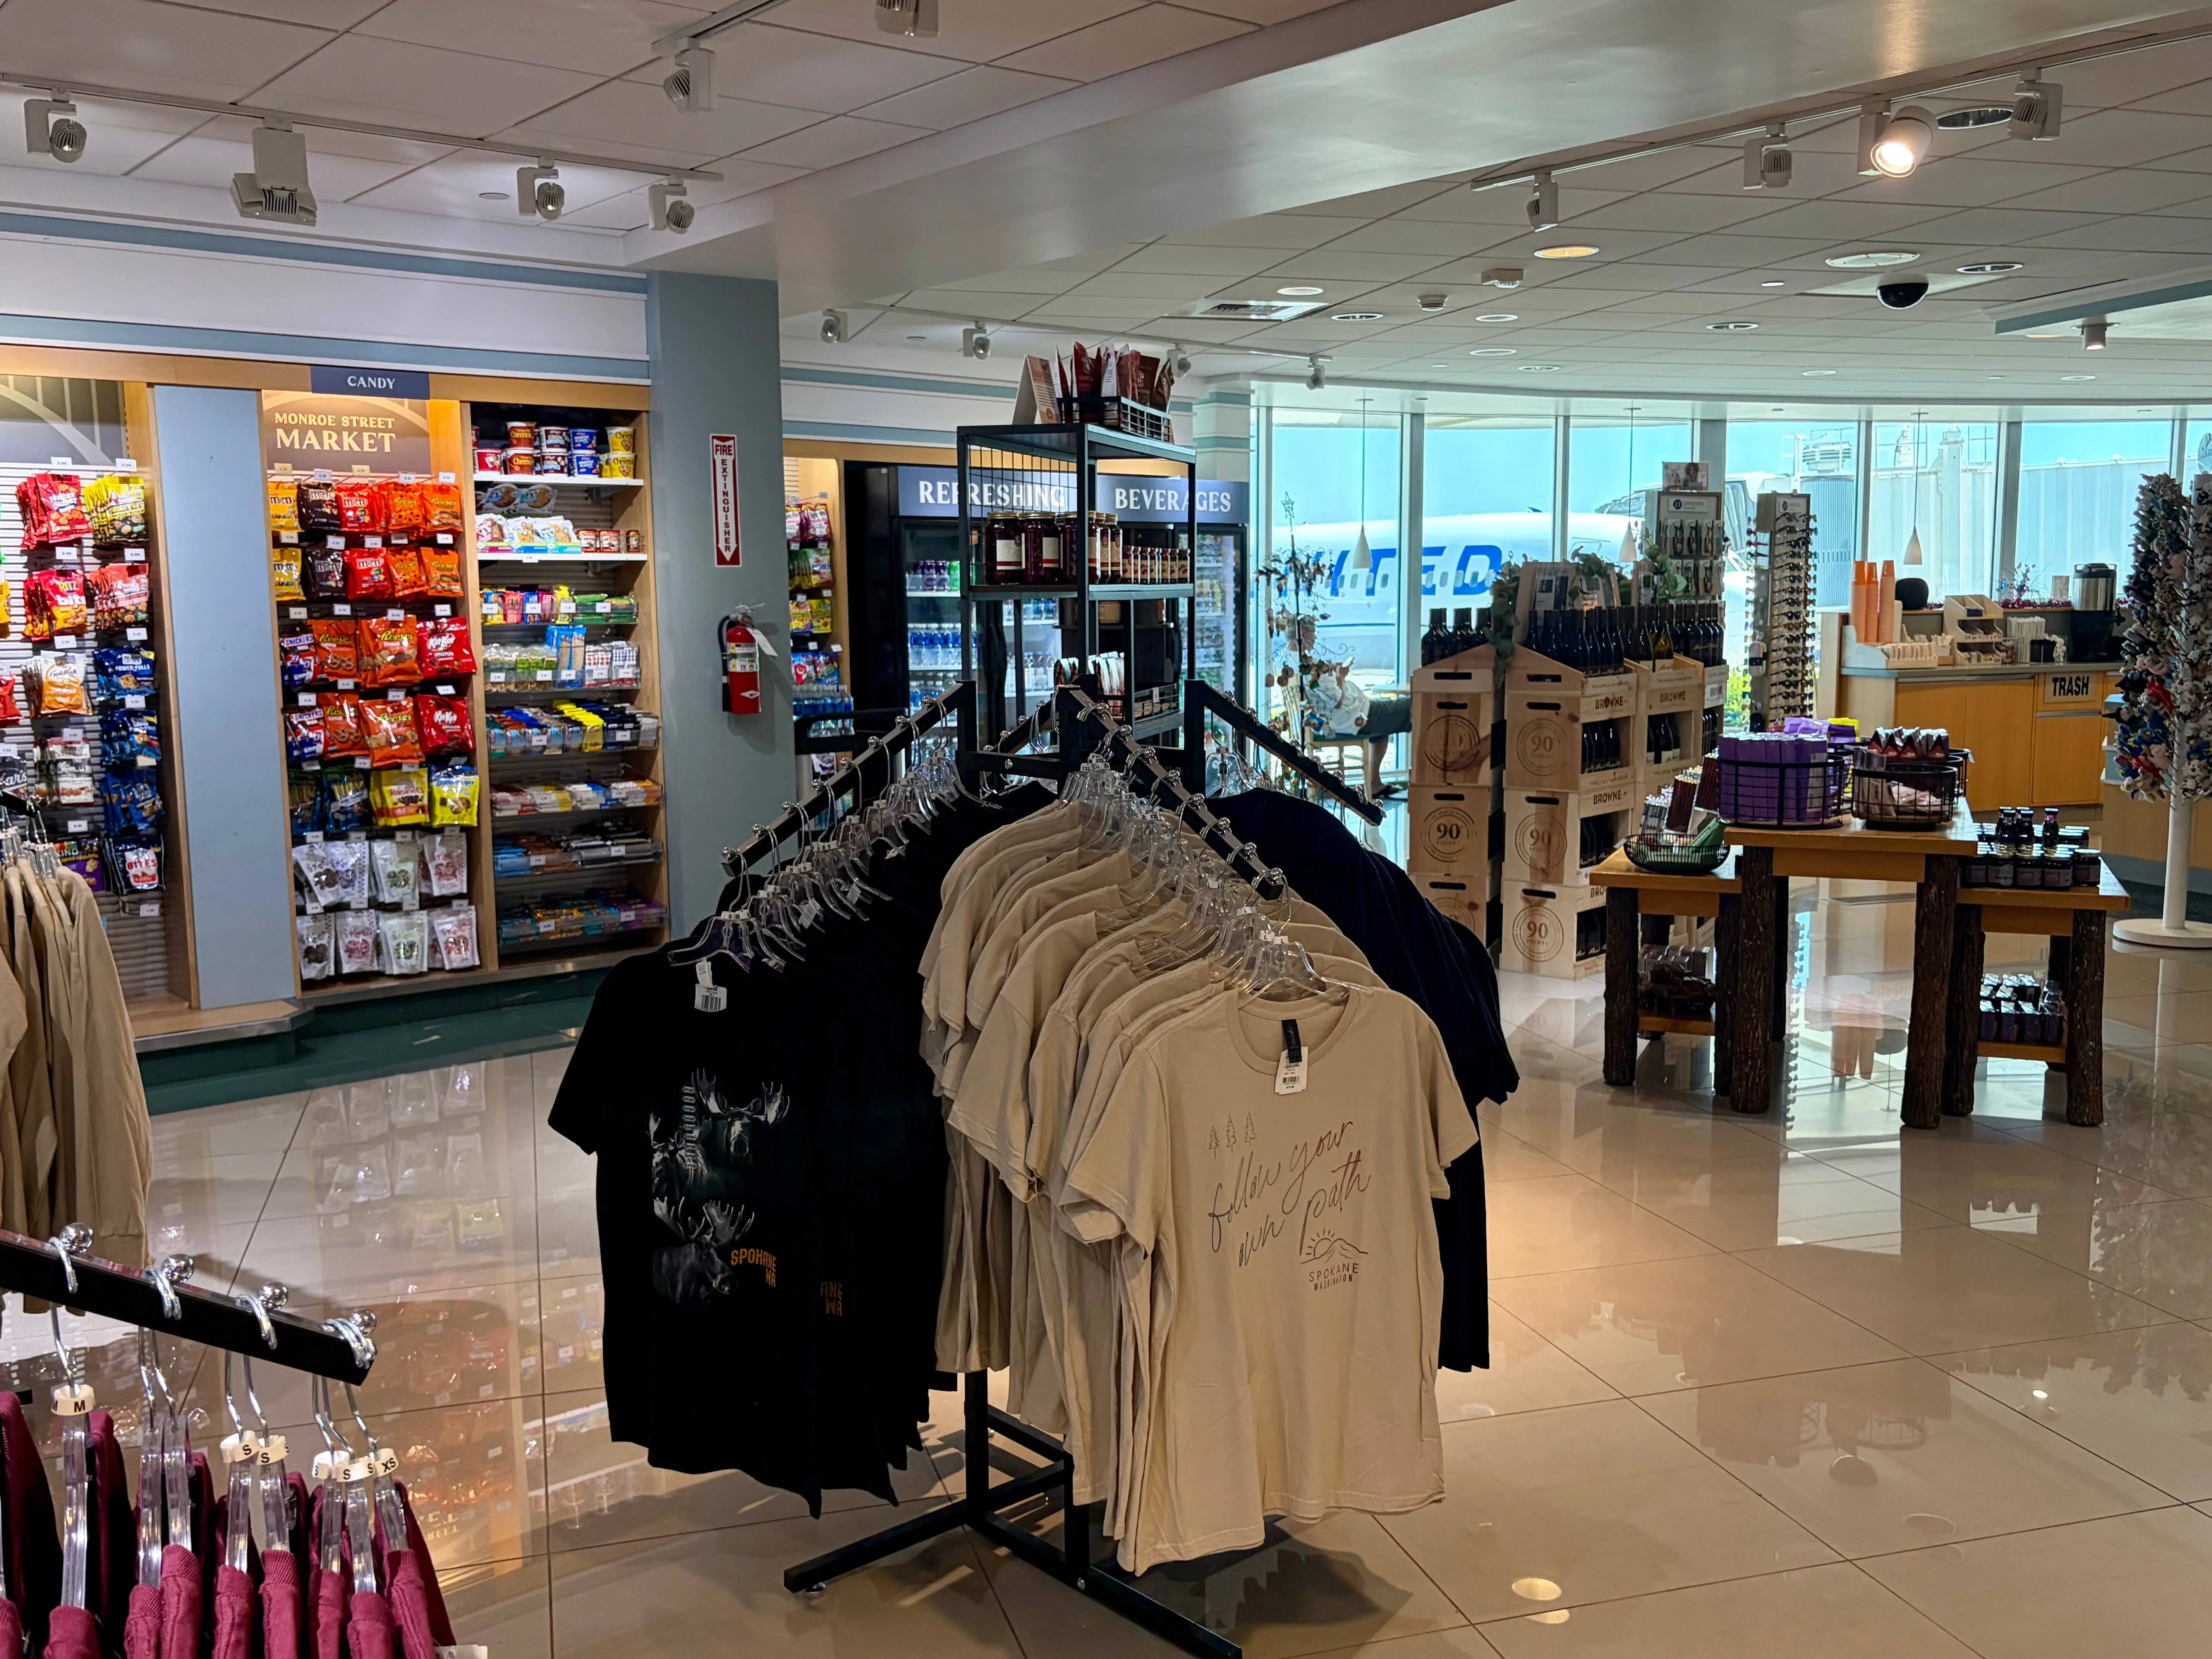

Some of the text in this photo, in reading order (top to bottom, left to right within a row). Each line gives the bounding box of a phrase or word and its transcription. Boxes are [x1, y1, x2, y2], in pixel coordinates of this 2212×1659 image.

[347, 376, 396, 389] CANDY
[275, 412, 395, 429] MONROE STREET
[276, 428, 396, 453] MARKET
[715, 444, 733, 456] FIRE
[919, 480, 1231, 512] REFRESHING BEVERAGES
[721, 459, 731, 553] EXTINGUISHER
[1283, 545, 1502, 596] ITED
[59, 580, 77, 591] RITZ
[286, 634, 314, 646] SNICKERS
[2052, 676, 2090, 697] TRASH
[1595, 696, 1623, 710] BROWNE
[1660, 690, 1686, 703] BROWNE
[1593, 790, 1621, 805] BROWNE
[1530, 829, 1551, 847] 90
[127, 859, 157, 870] BITES
[1526, 921, 1548, 939] 90
[1208, 1121, 1353, 1253] follow your
[1239, 1149, 1371, 1267] own path
[731, 1248, 776, 1273] SPOKANE
[766, 1267, 776, 1287] WA
[1308, 1262, 1359, 1283] SPOKANE
[1313, 1273, 1353, 1292] WASHINGTON
[825, 1298, 842, 1317] WA
[74, 1400, 86, 1412] M
[242, 1444, 252, 1456] S
[261, 1453, 270, 1463] S
[381, 1457, 397, 1473] XS
[343, 1469, 351, 1480] S
